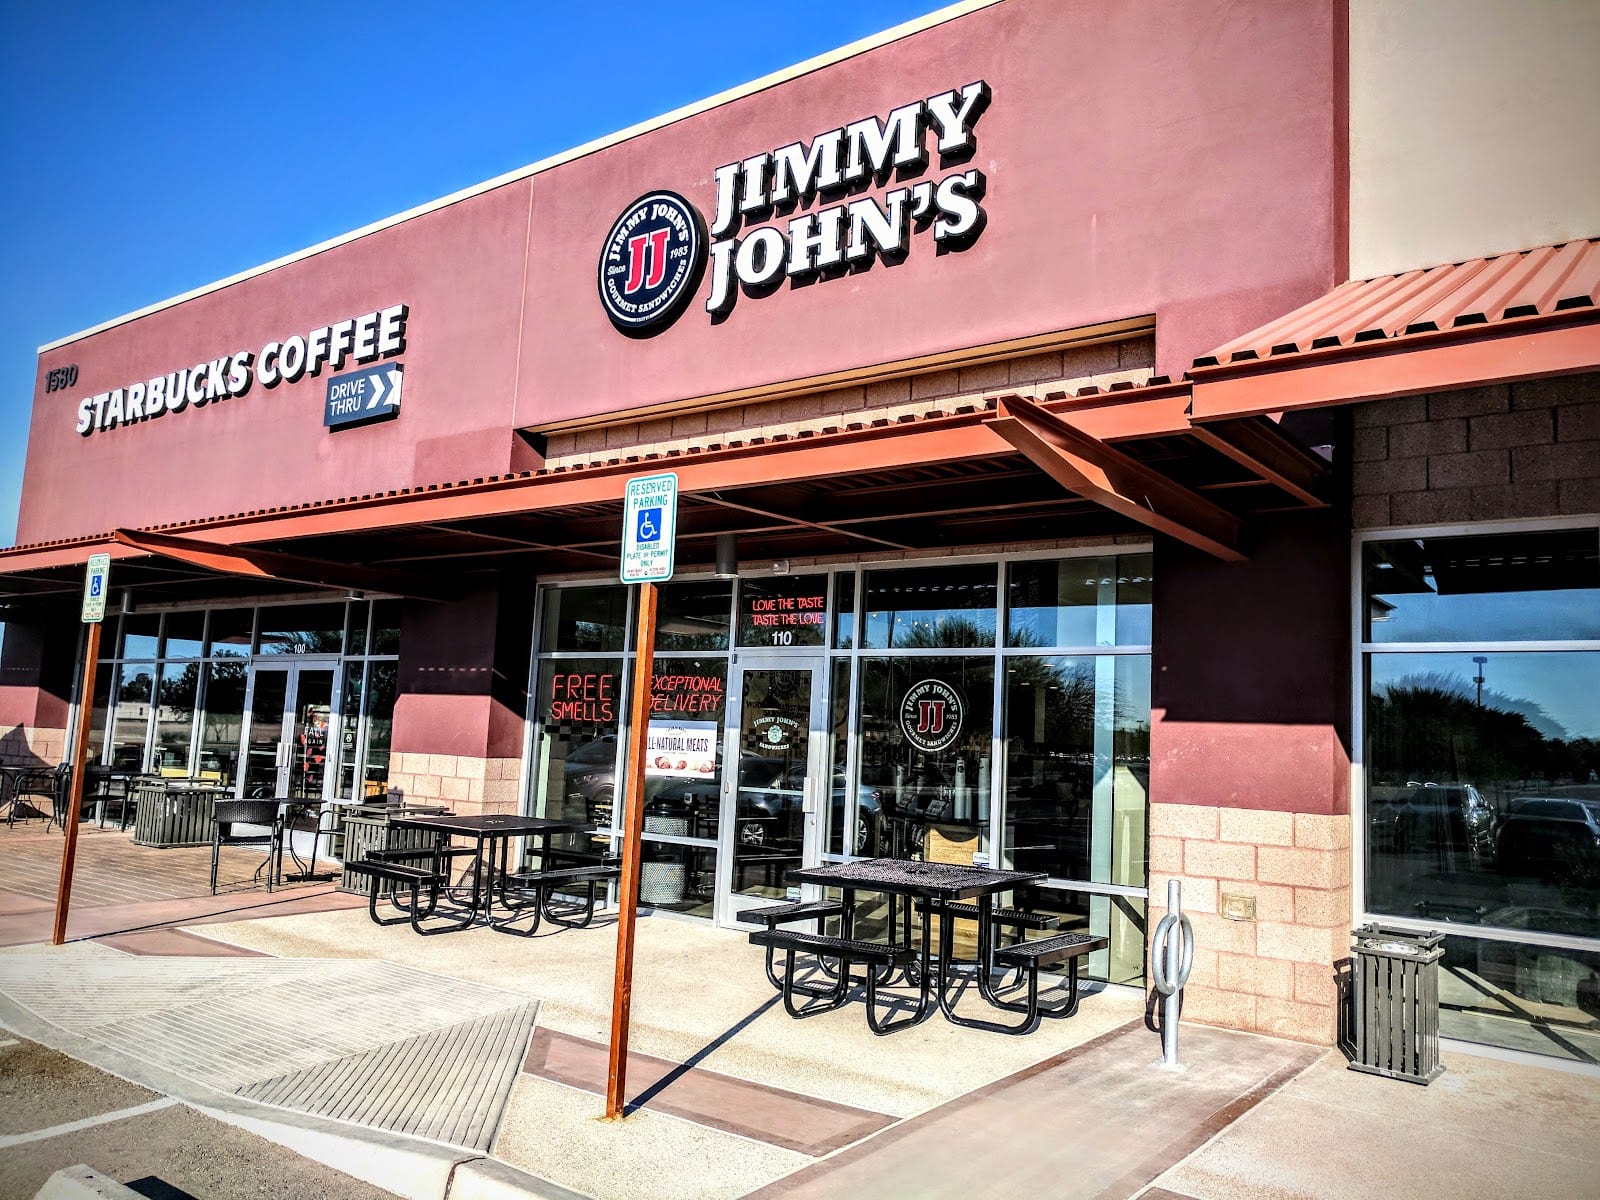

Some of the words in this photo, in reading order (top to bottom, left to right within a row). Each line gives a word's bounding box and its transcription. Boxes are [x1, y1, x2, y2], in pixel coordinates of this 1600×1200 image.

[711, 80, 987, 237] JIMMY
[609, 206, 648, 262] JIMMY
[650, 203, 689, 242] JOHN'S
[706, 169, 987, 314] JOHN'S
[607, 265, 626, 275] Since
[669, 245, 689, 260] 1983
[624, 227, 671, 294] JJ
[607, 278, 638, 313] GOURMET
[638, 259, 687, 313] SANDWICHES
[45, 364, 79, 393] 1580
[76, 351, 253, 435] STARBUCKS
[257, 303, 407, 386] COFFEE
[330, 378, 366, 401] DRIVE
[330, 395, 362, 417] THRU
[630, 480, 672, 496] RESERVED
[633, 494, 668, 509] PARKING
[626, 552, 641, 560] PLATE
[650, 549, 669, 558] PERMIT
[636, 542, 660, 551] DISABLED
[752, 599, 776, 611] LOVE
[778, 598, 795, 610] THE
[797, 596, 825, 609] TASTE
[752, 613, 780, 626] TASTE
[780, 613, 798, 625] THE
[799, 612, 824, 625] LOVE
[293, 643, 306, 654] 100
[771, 630, 792, 646] 110
[552, 674, 614, 701] FREE
[905, 684, 930, 711] JIMMY
[932, 684, 958, 711] JOHN'S
[551, 701, 613, 722] SMELLS
[753, 716, 776, 728] JIMMY
[917, 700, 946, 733] JJ
[648, 736, 685, 751] LL-NATURAL
[686, 737, 709, 752] MEATS
[905, 720, 926, 745] GOURMET
